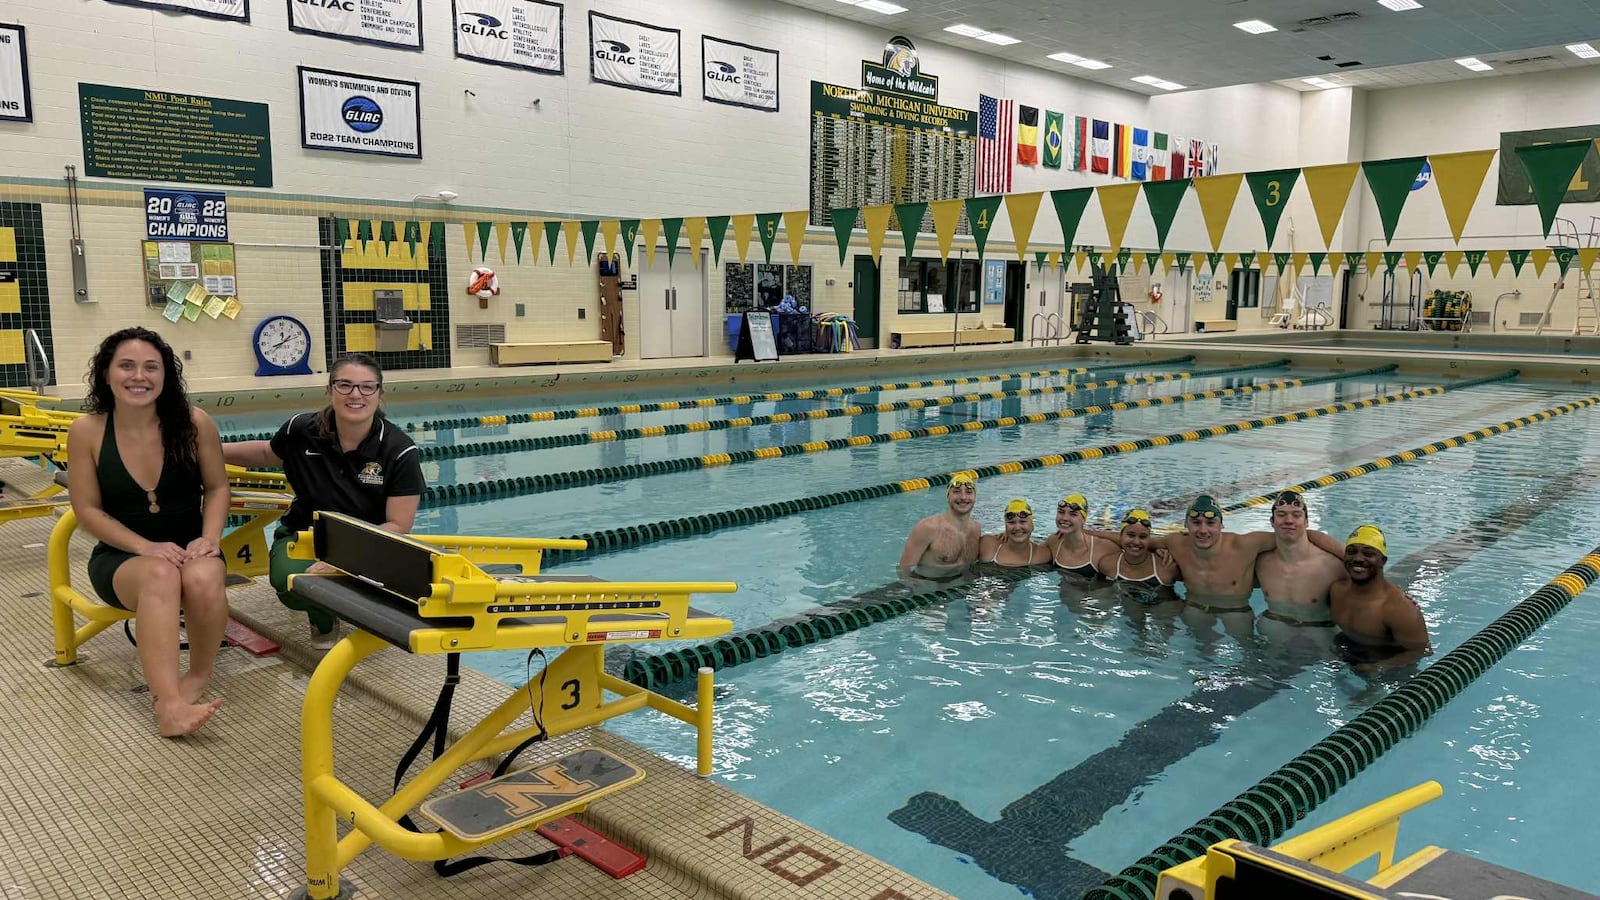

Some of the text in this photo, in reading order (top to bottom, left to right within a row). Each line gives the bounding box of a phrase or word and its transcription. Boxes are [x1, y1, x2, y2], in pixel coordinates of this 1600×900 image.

[301, 0, 354, 12] LIAC
[460, 23, 508, 40] GLIAC
[596, 50, 636, 64] GLIAC
[707, 71, 741, 84] GLIAC
[866, 71, 935, 95] Home of the Wildcats
[308, 76, 338, 88] WOMEN'S
[340, 80, 376, 92] SWIMMING
[390, 88, 412, 97] DIVING
[144, 92, 212, 106] NMU Pool Rules
[823, 84, 969, 121] NORTHERN MICHIGAN UNIVERSITY
[346, 110, 380, 123] GLIAC
[850, 102, 887, 116] SWIMMING
[896, 111, 920, 121] DIVING
[921, 115, 948, 126] RECORDS
[310, 132, 414, 150] 2022 TEAM CHAMPIONS
[1265, 180, 1281, 207] 3
[148, 197, 225, 217] 20 22
[977, 208, 988, 229] 4
[149, 223, 226, 237] CHAMPIONS
[517, 228, 523, 241] 7
[627, 226, 634, 242] 6
[767, 221, 774, 239] 5
[623, 374, 638, 383] 30
[446, 383, 464, 392] 20
[216, 397, 234, 407] 10
[237, 544, 252, 564] 4
[561, 679, 581, 710] 3
[480, 762, 598, 818] N
[350, 811, 356, 824] 3
[704, 816, 843, 888] NO
